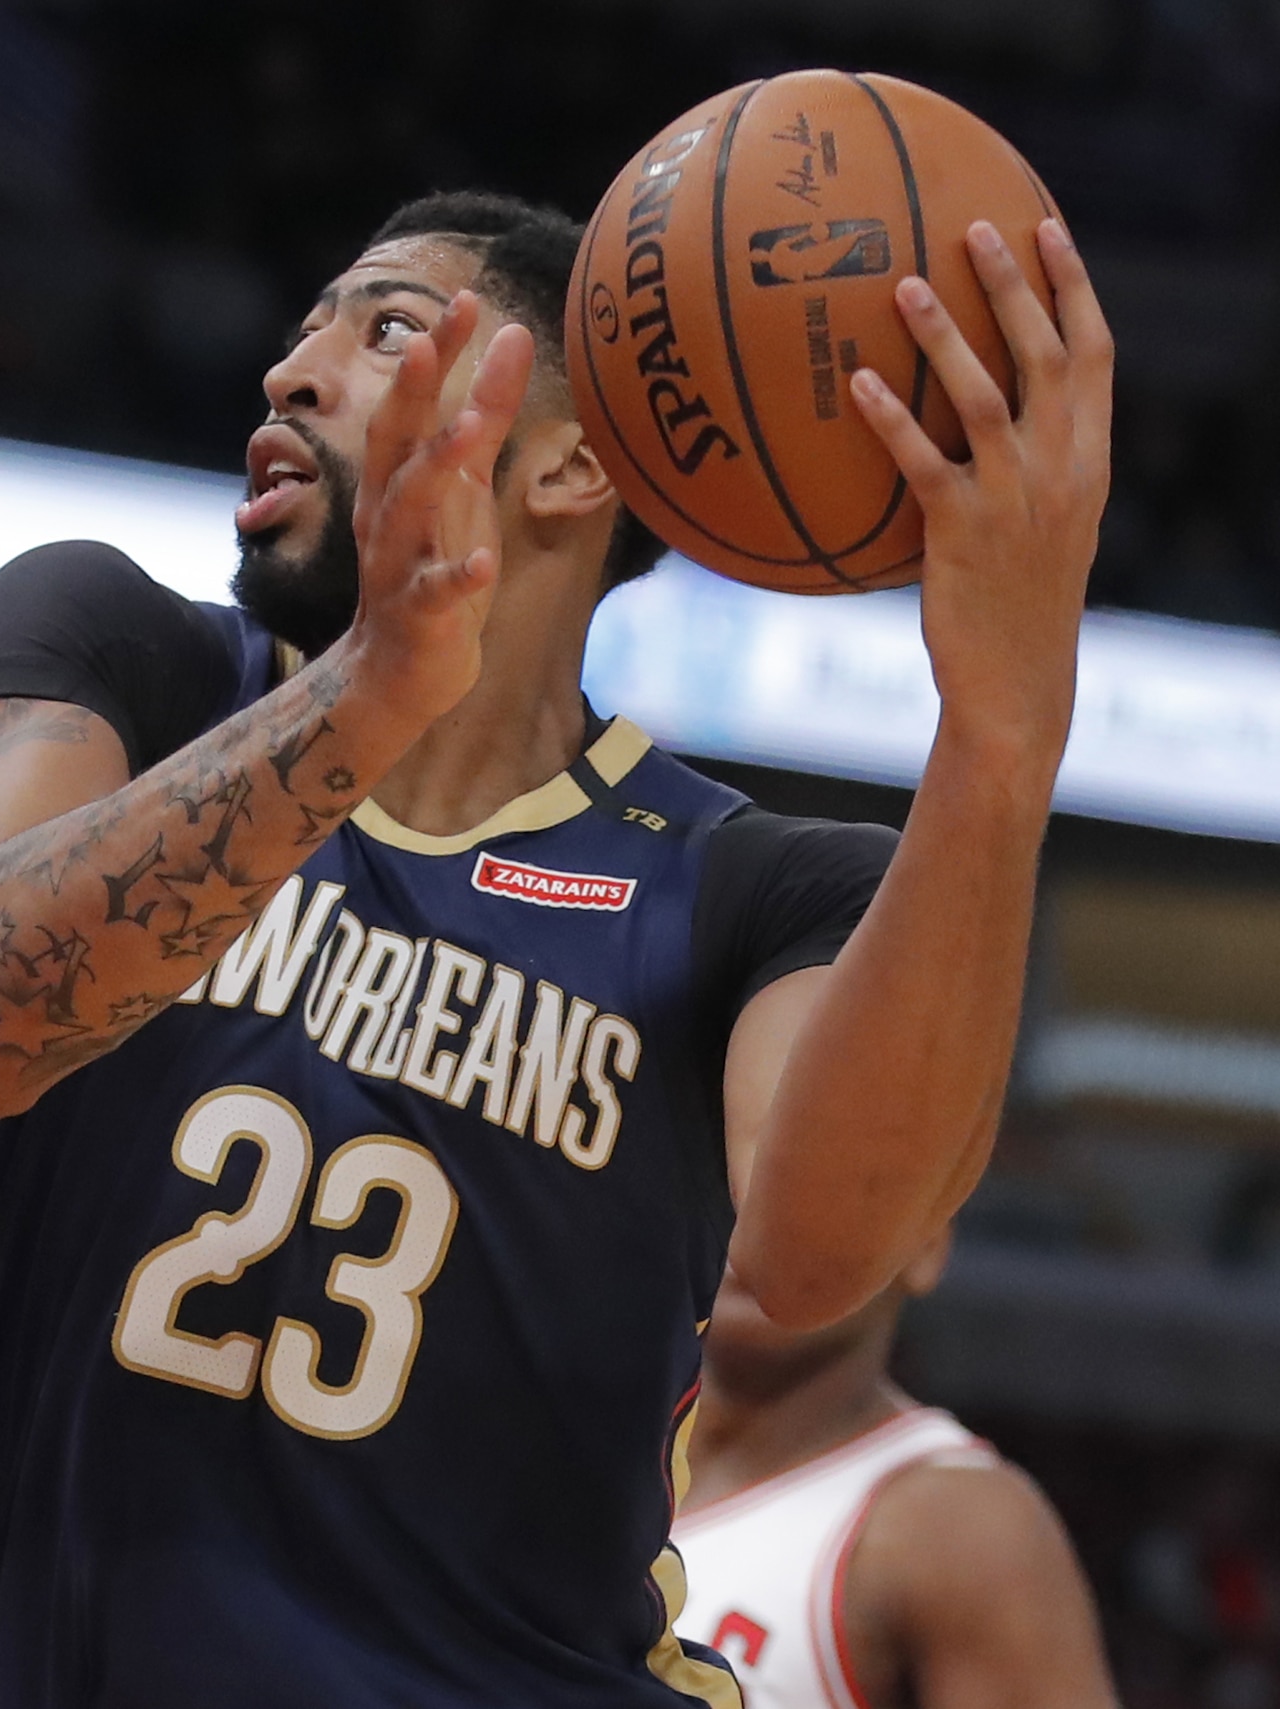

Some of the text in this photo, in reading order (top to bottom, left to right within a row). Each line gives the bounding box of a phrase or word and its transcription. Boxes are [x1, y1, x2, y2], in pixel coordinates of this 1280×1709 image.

[625, 127, 741, 476] SPALDING
[493, 867, 622, 899] ZATARAIN'S
[622, 807, 668, 832] TB
[304, 907, 642, 1171] ORLEANS
[111, 1084, 459, 1440] 23
